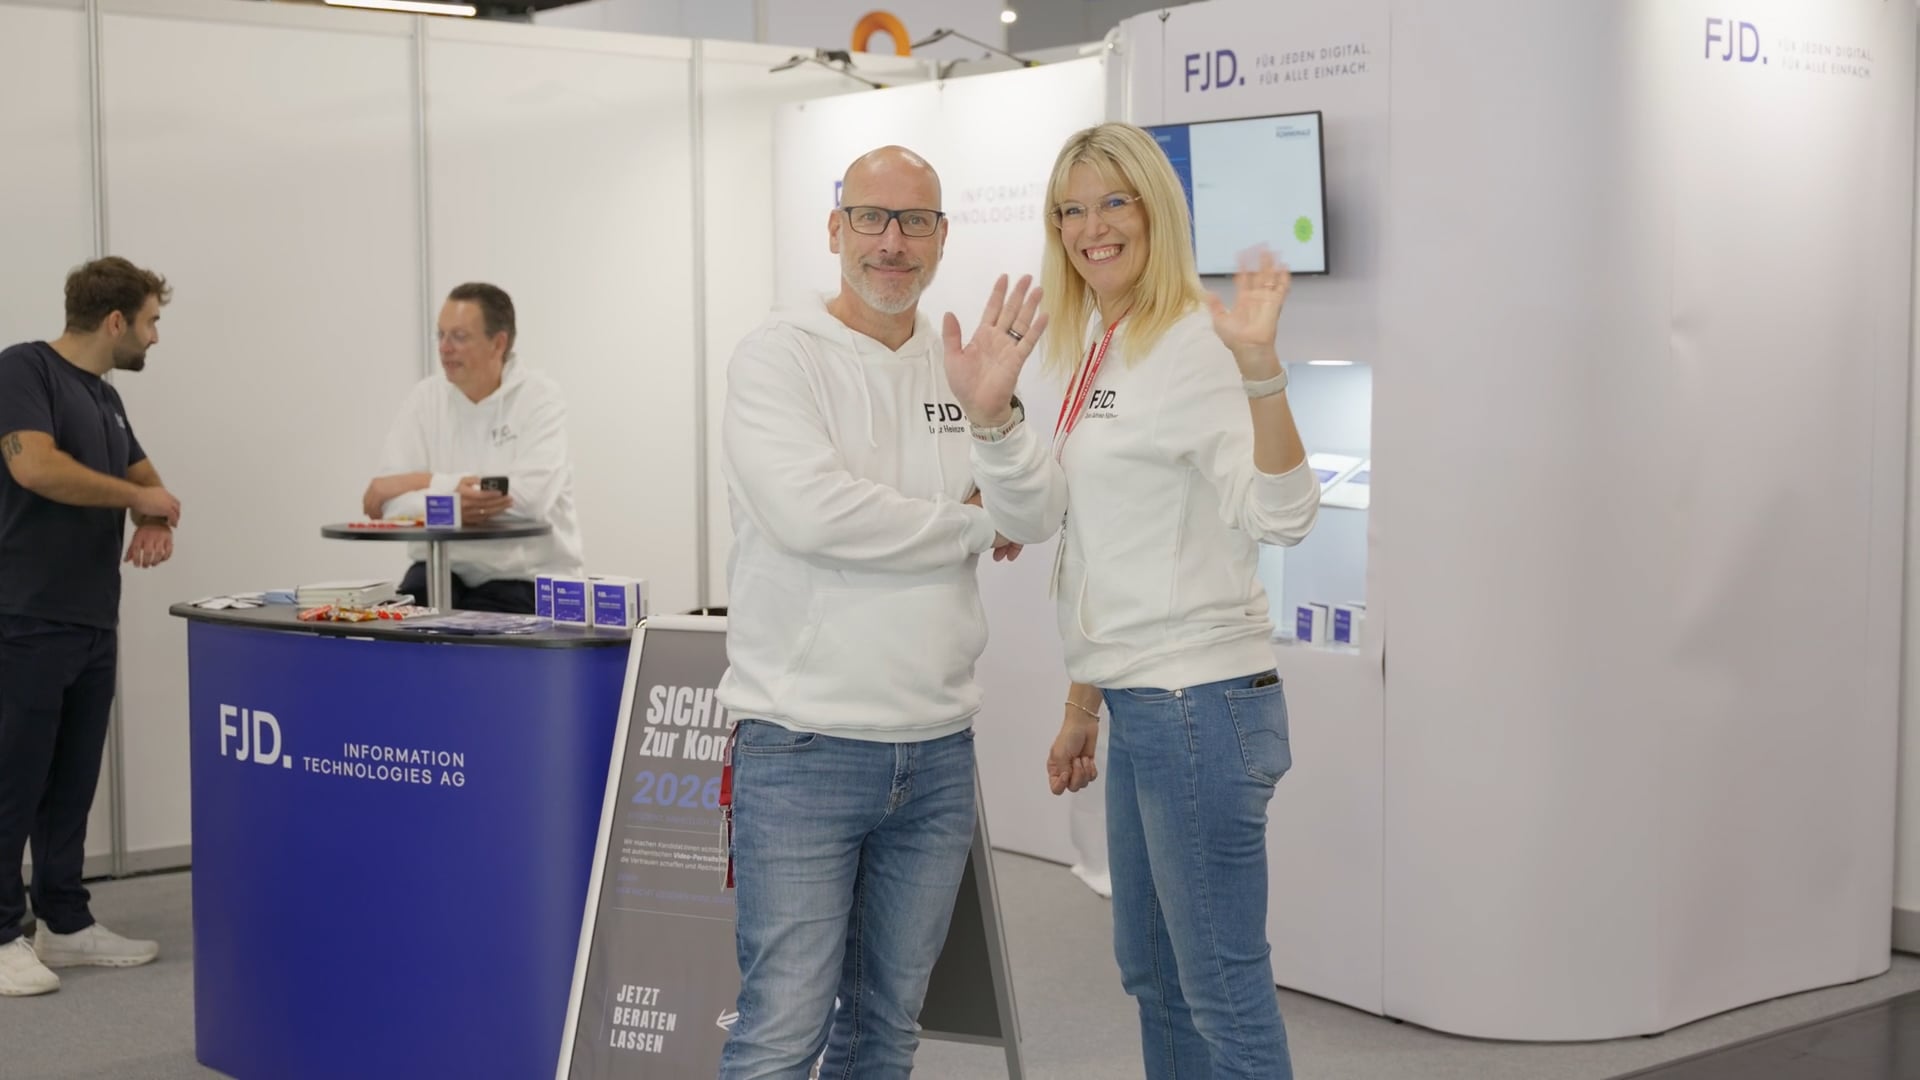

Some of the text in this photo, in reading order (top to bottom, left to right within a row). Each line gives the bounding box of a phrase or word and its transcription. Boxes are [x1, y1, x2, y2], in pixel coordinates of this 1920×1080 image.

[1704, 17, 1768, 65] FJD.
[1185, 49, 1245, 93] FJD.
[1256, 54, 1275, 68] FÜR
[1280, 50, 1315, 66] JEDEN
[1259, 71, 1279, 85] FÜR
[1284, 68, 1308, 83] ALLE
[924, 403, 967, 422] FJD.
[1089, 390, 1116, 409] FJD.
[646, 684, 735, 729] SICHT
[220, 704, 292, 769] FJD.
[640, 727, 679, 759] Zur
[344, 743, 464, 768] INFORMATION
[303, 756, 465, 788] TECHNOLOGIES AG
[632, 770, 721, 811] 2026
[616, 984, 661, 1006] JETZT
[613, 1006, 677, 1032] BERATEN
[609, 1028, 664, 1054] LASSEN
